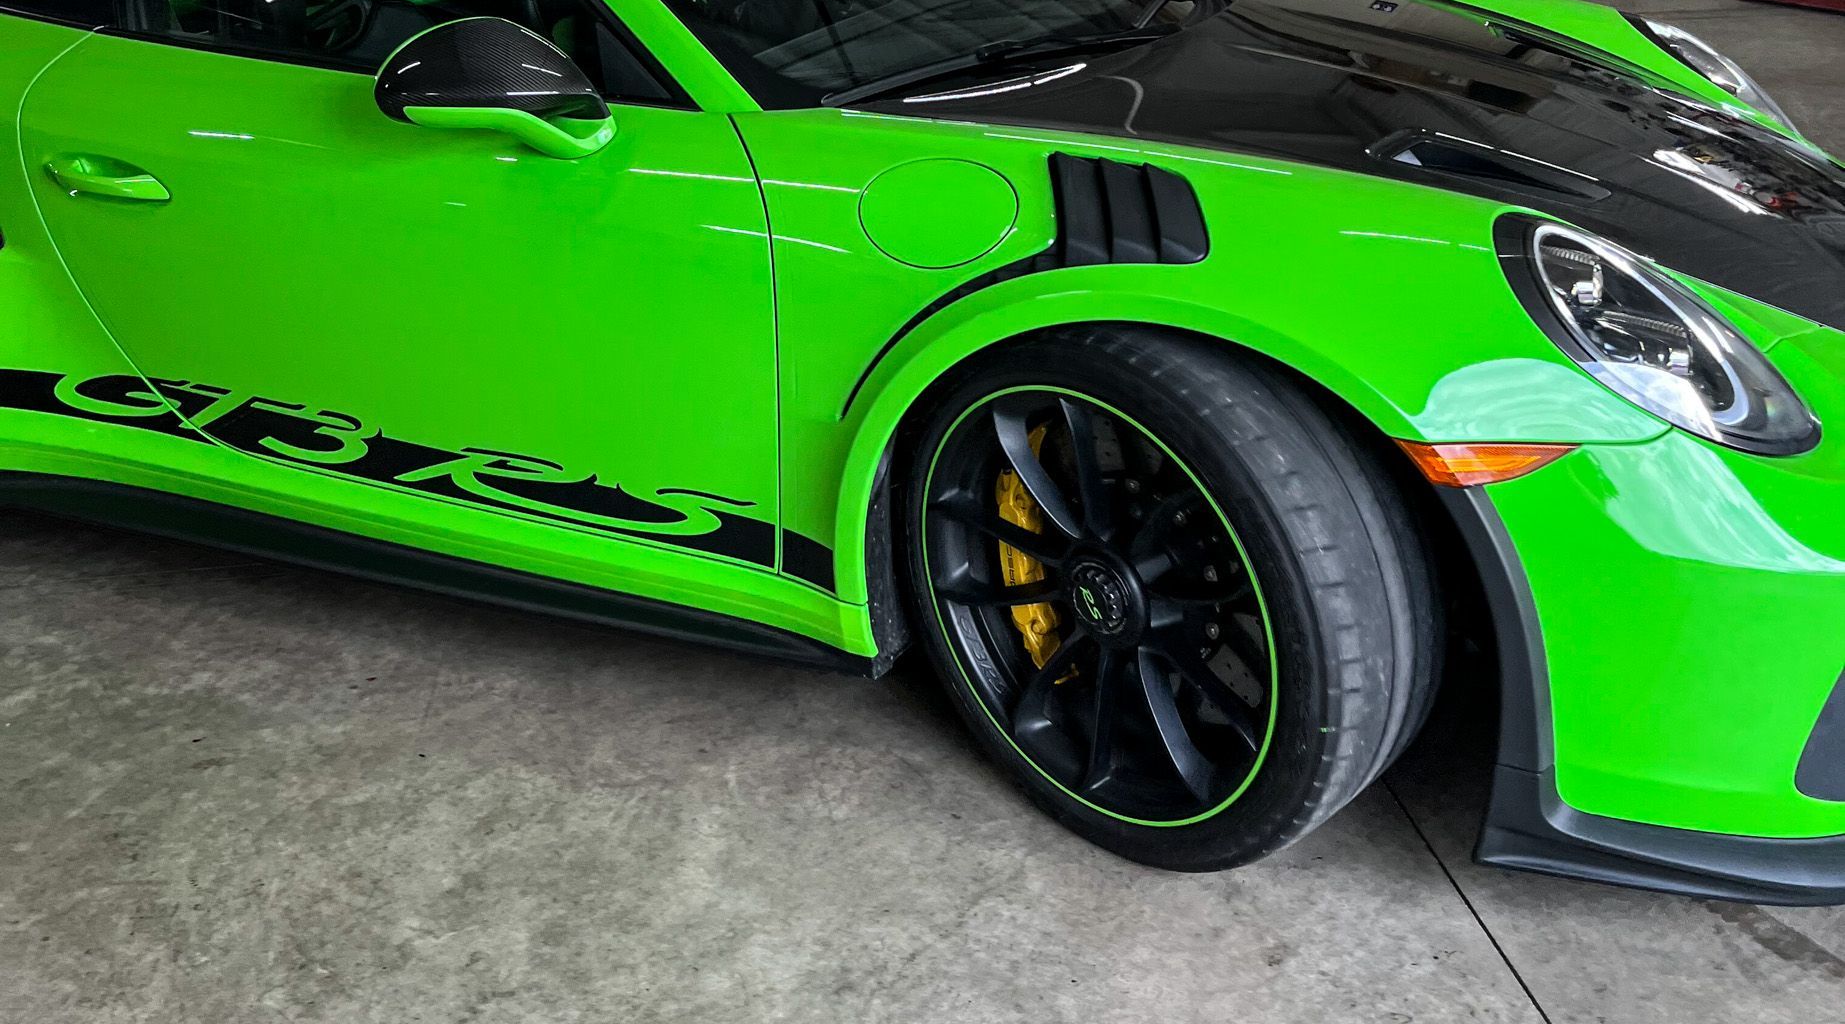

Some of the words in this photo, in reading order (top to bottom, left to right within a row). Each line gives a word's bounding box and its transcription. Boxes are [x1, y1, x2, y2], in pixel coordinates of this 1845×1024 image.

[53, 373, 384, 466] GT3
[393, 445, 757, 538] RS
[1079, 586, 1104, 620] RS
